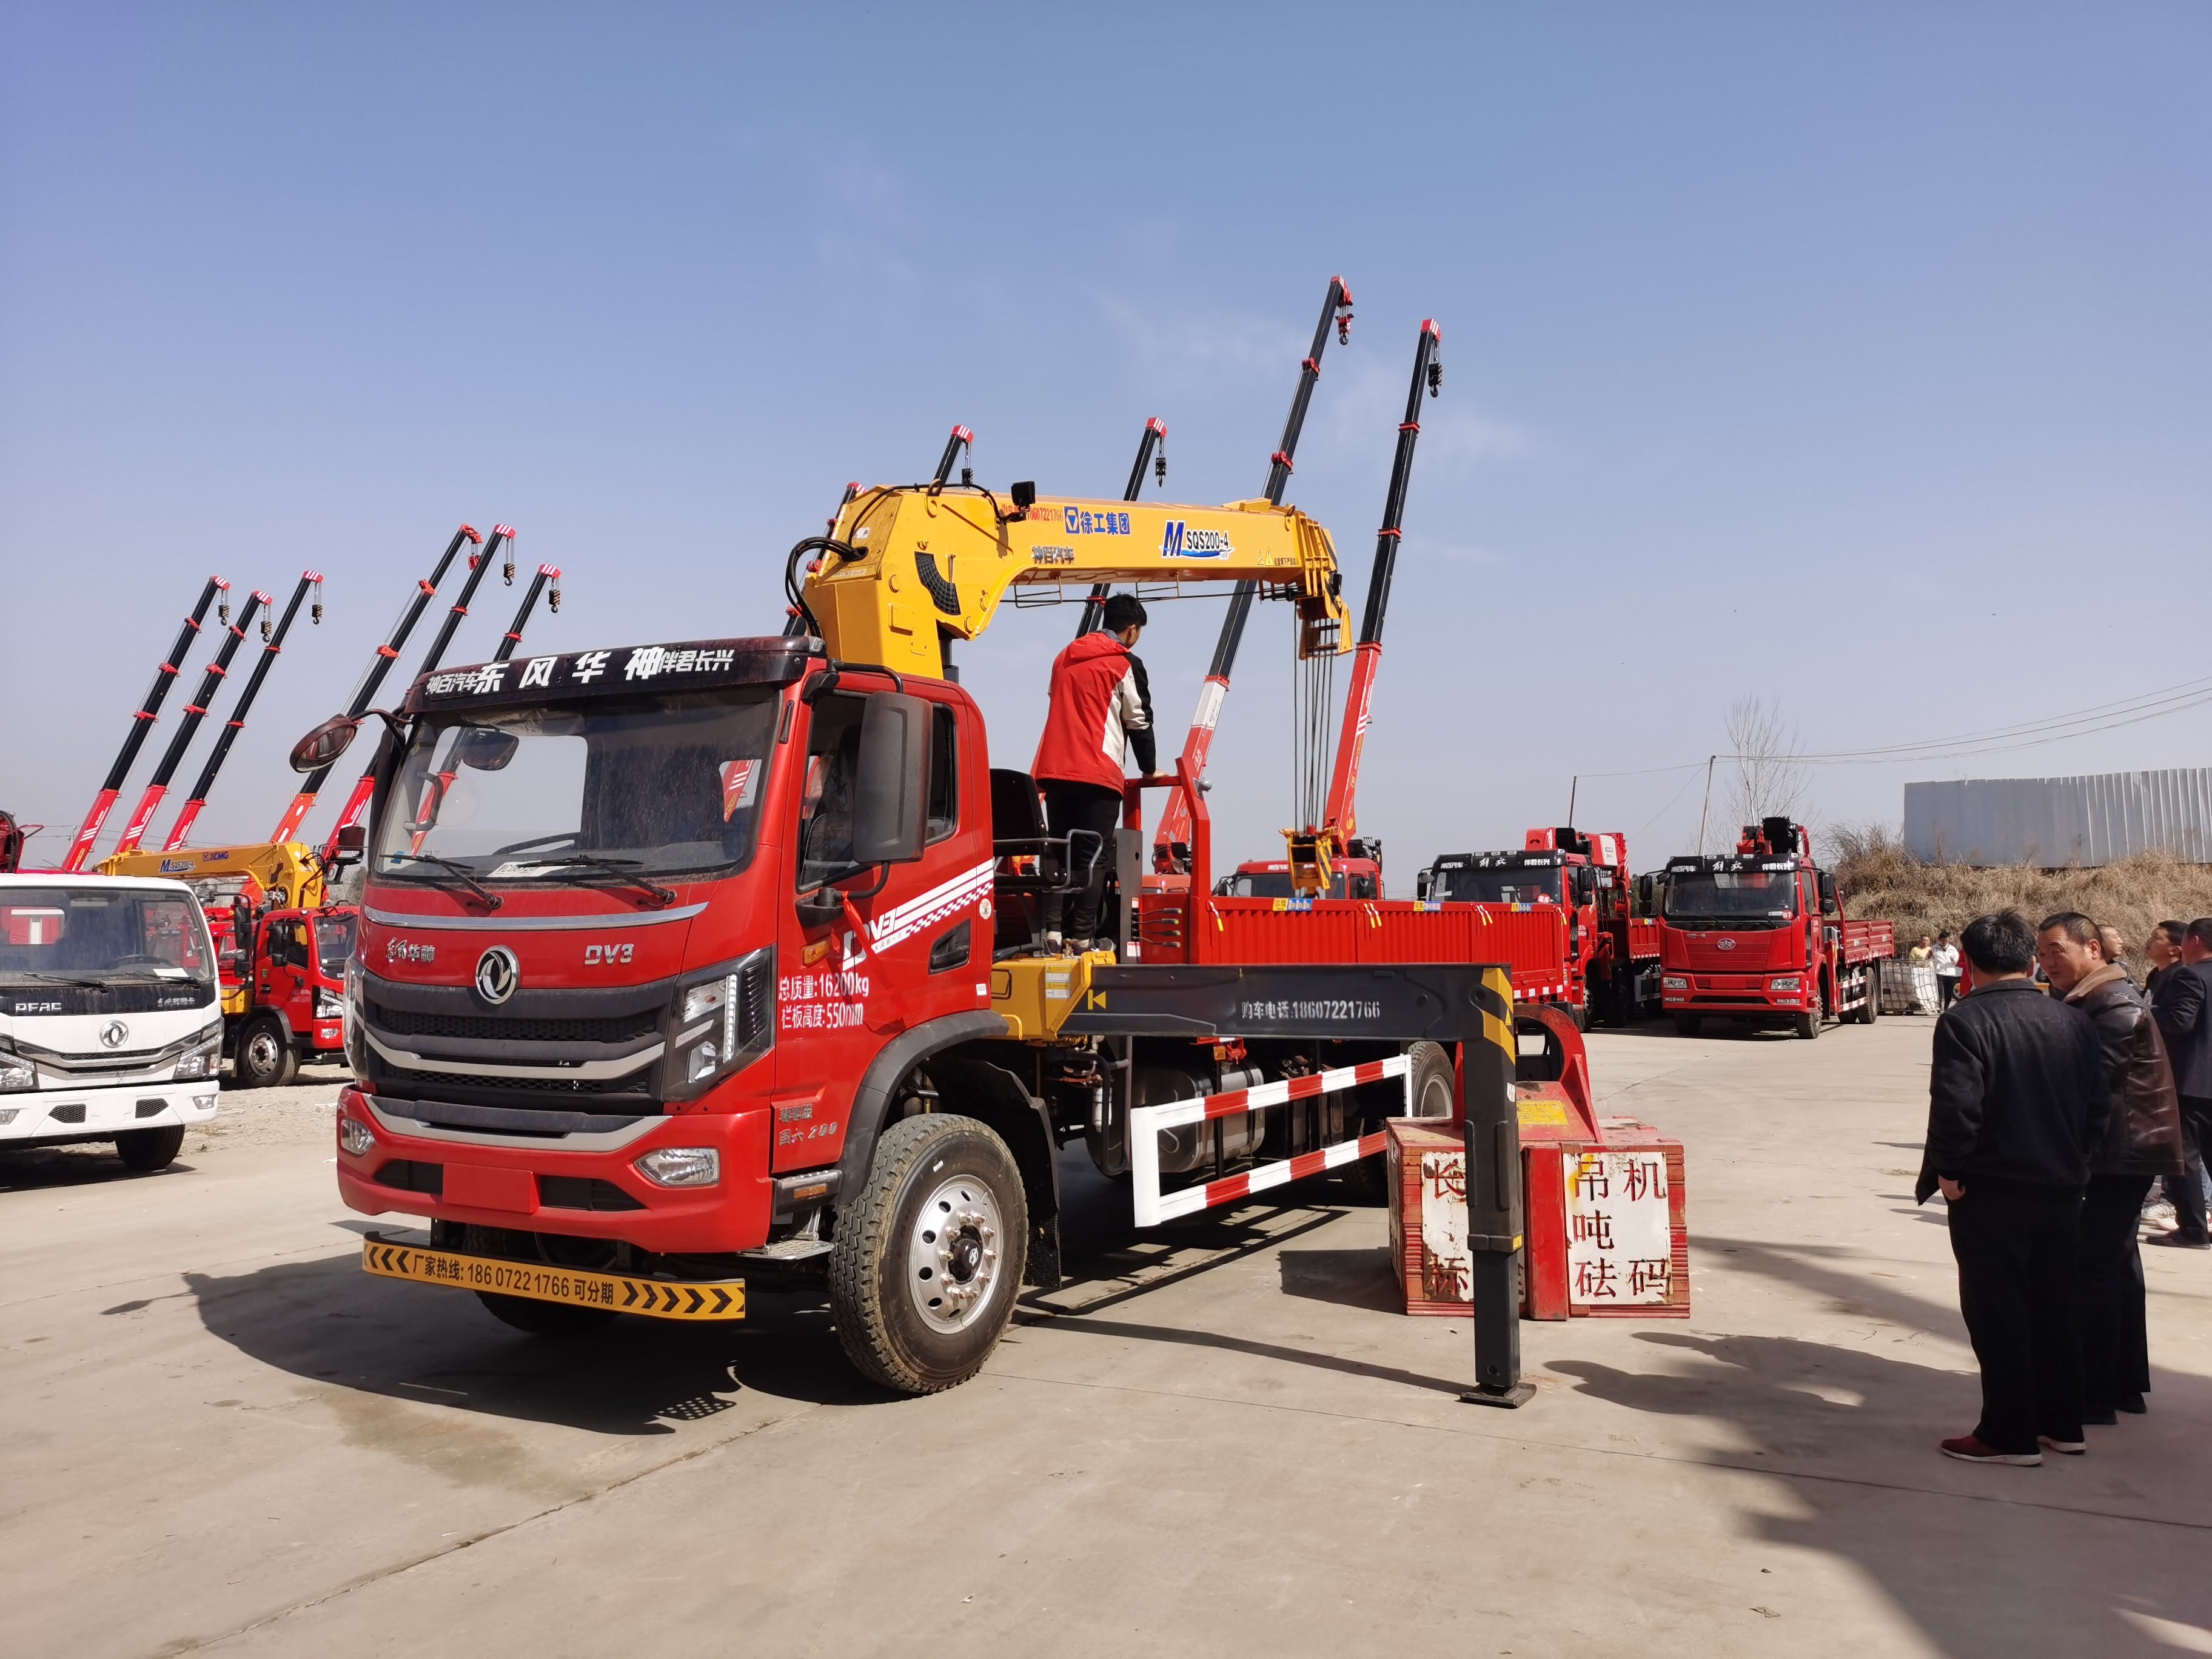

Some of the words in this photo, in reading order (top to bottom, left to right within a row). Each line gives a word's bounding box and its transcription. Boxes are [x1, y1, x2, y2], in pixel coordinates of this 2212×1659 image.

[1080, 511, 1130, 535] 徐工集团
[1162, 521, 1184, 556] M
[1187, 530, 1228, 549] SQS200-4
[426, 672, 478, 695] 神百汽车
[474, 647, 664, 694] 东风华神
[659, 649, 733, 672] 伴君长兴
[160, 859, 171, 873] M
[171, 859, 194, 869] SQS200-4
[209, 851, 229, 860] XCMG
[386, 937, 436, 963] 东风华神
[584, 943, 634, 965] DV3
[874, 932, 902, 951] 东风新一代
[15, 1002, 62, 1014] DFAC
[808, 1122, 838, 1139] 200
[1575, 1159, 1667, 1202] 吊机
[1573, 1209, 1615, 1250] 吨
[1575, 1257, 1672, 1299] 砝码
[574, 1278, 614, 1305] 可分期
